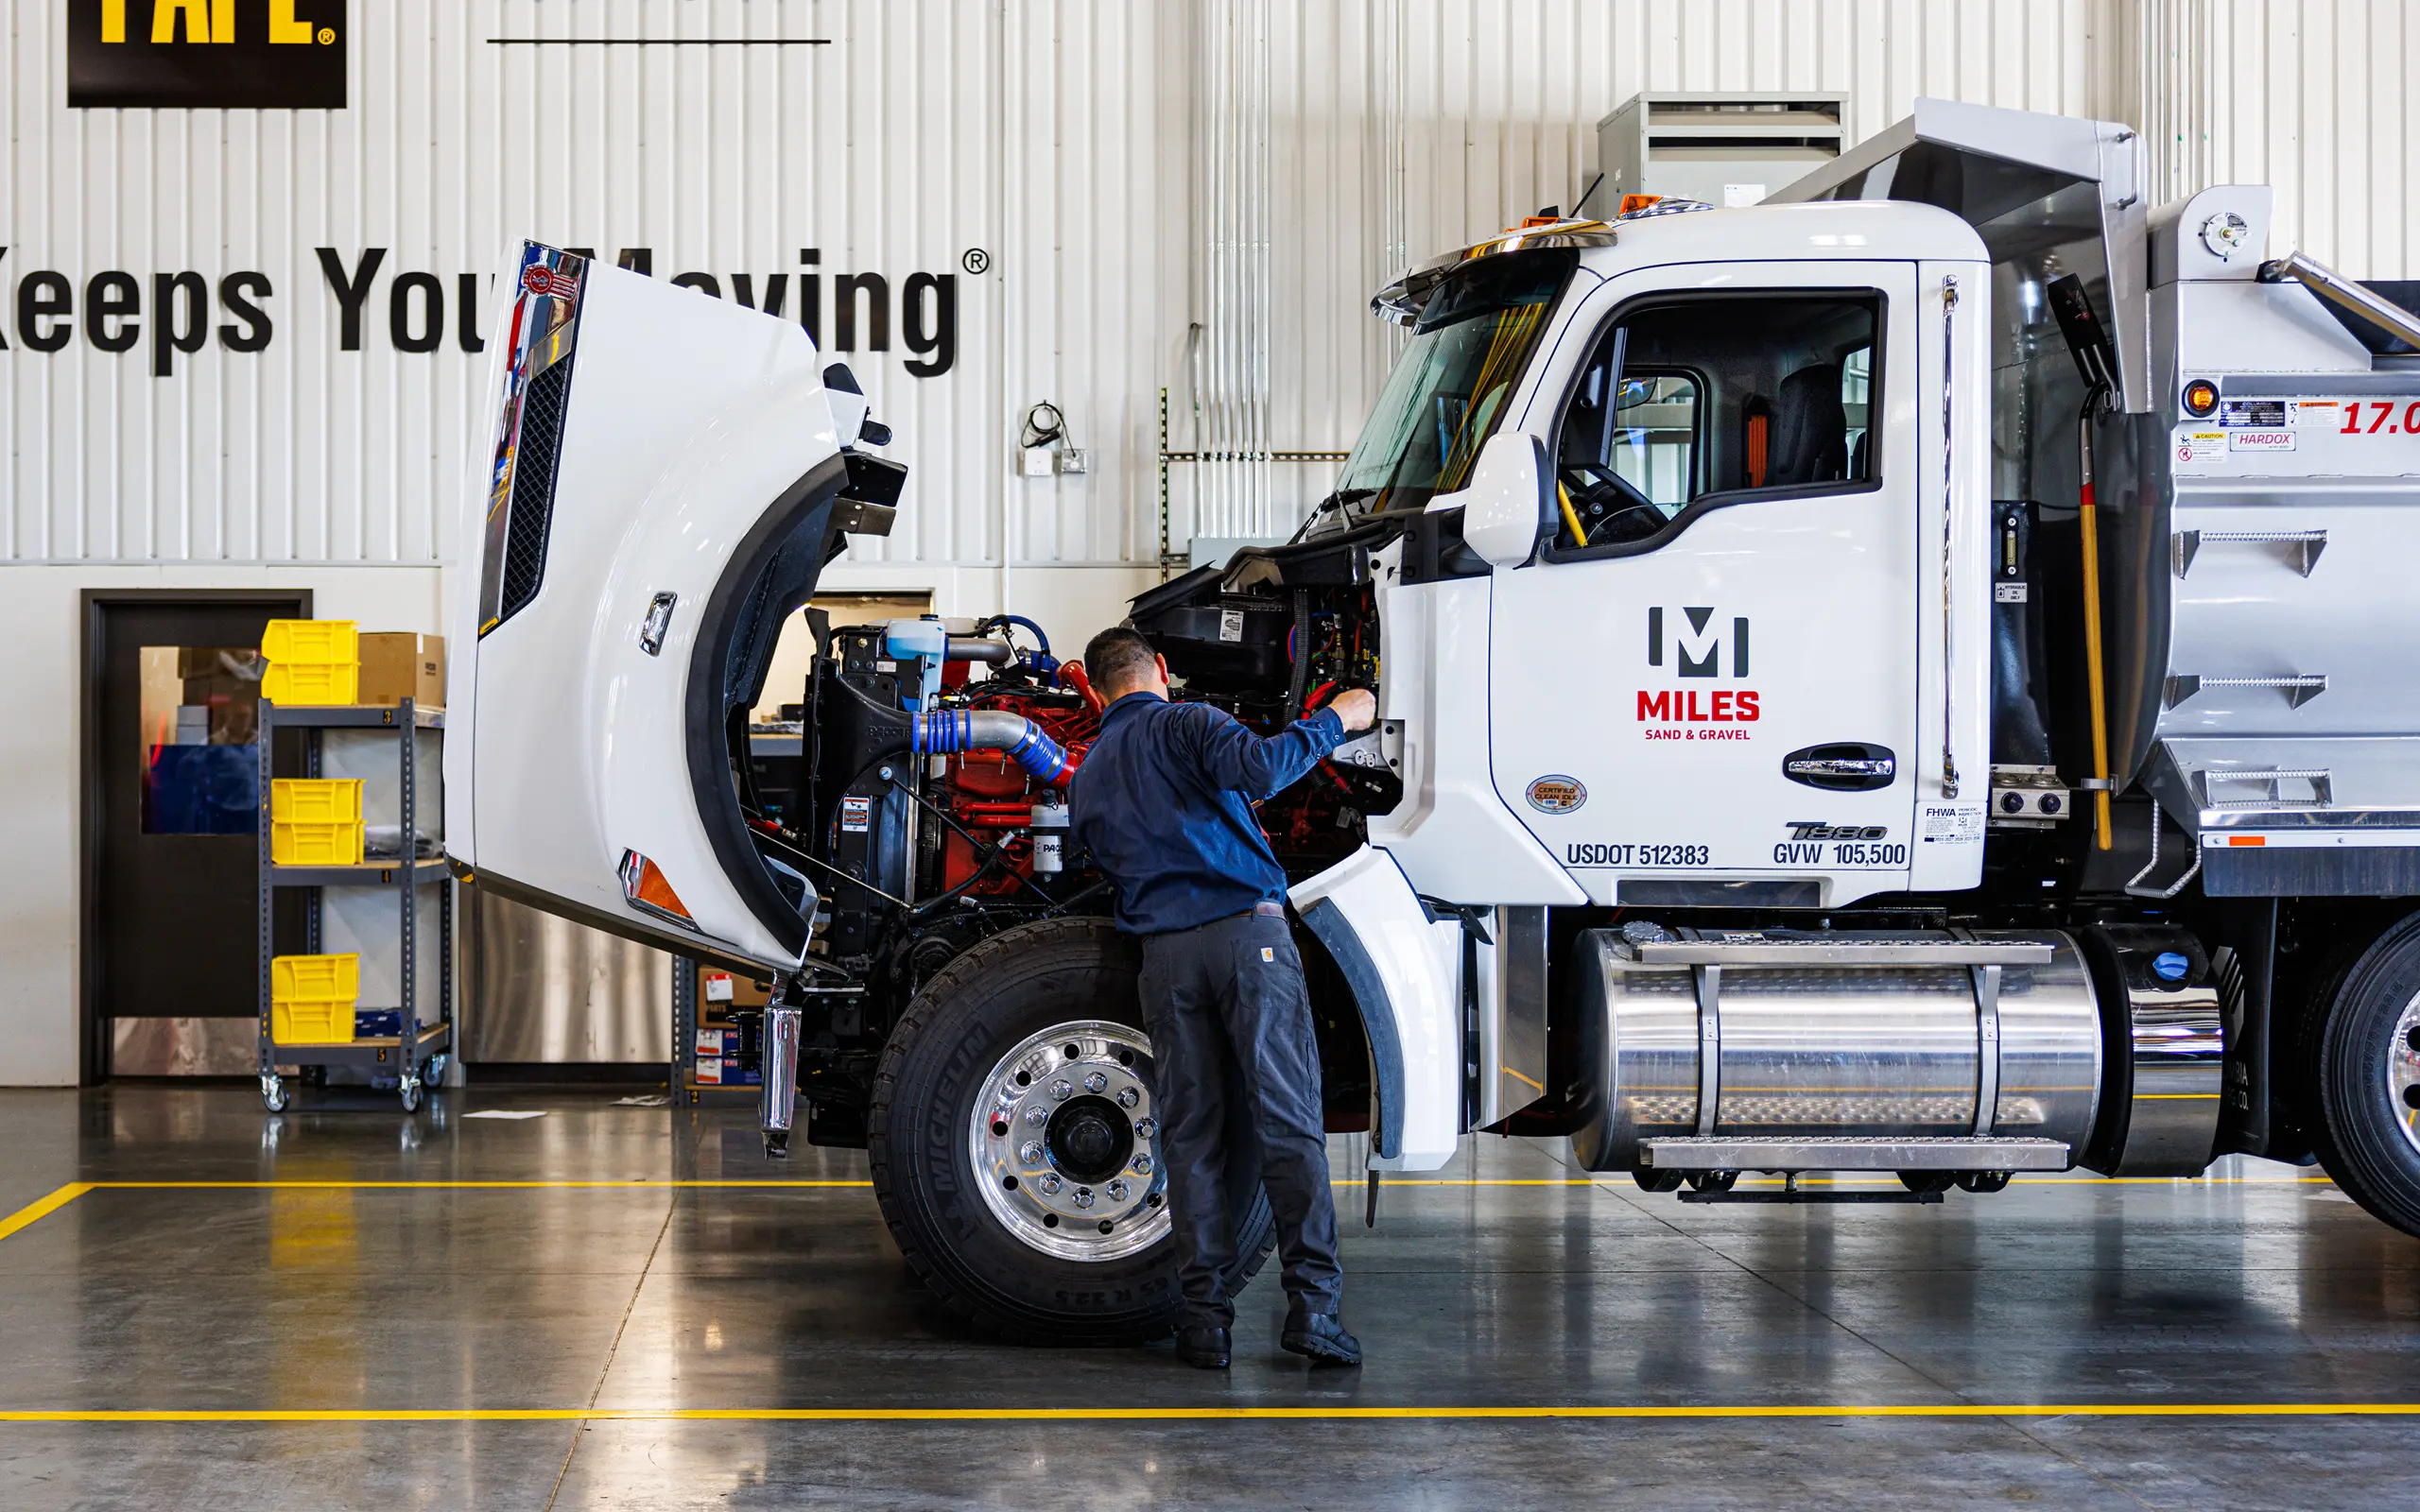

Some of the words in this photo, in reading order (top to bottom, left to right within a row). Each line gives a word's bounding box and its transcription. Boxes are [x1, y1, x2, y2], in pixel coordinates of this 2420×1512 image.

[0, 248, 273, 376] eeps
[2340, 402, 2420, 434] 17.0
[2239, 435, 2290, 444] HARDOX
[384, 711, 390, 723] 3
[1637, 691, 1759, 721] MILES
[1645, 730, 1681, 740] SAND
[1685, 730, 1694, 740] &
[1699, 730, 1751, 740] GRAVEL
[1926, 808, 1956, 816] FHWA
[1786, 821, 1888, 841] T880
[1567, 844, 1635, 865] USDOT
[1639, 845, 1709, 866] 512383
[1773, 844, 1823, 864] GVW
[1833, 844, 1905, 867] 105,500
[929, 1023, 991, 1192] MICHELIN
